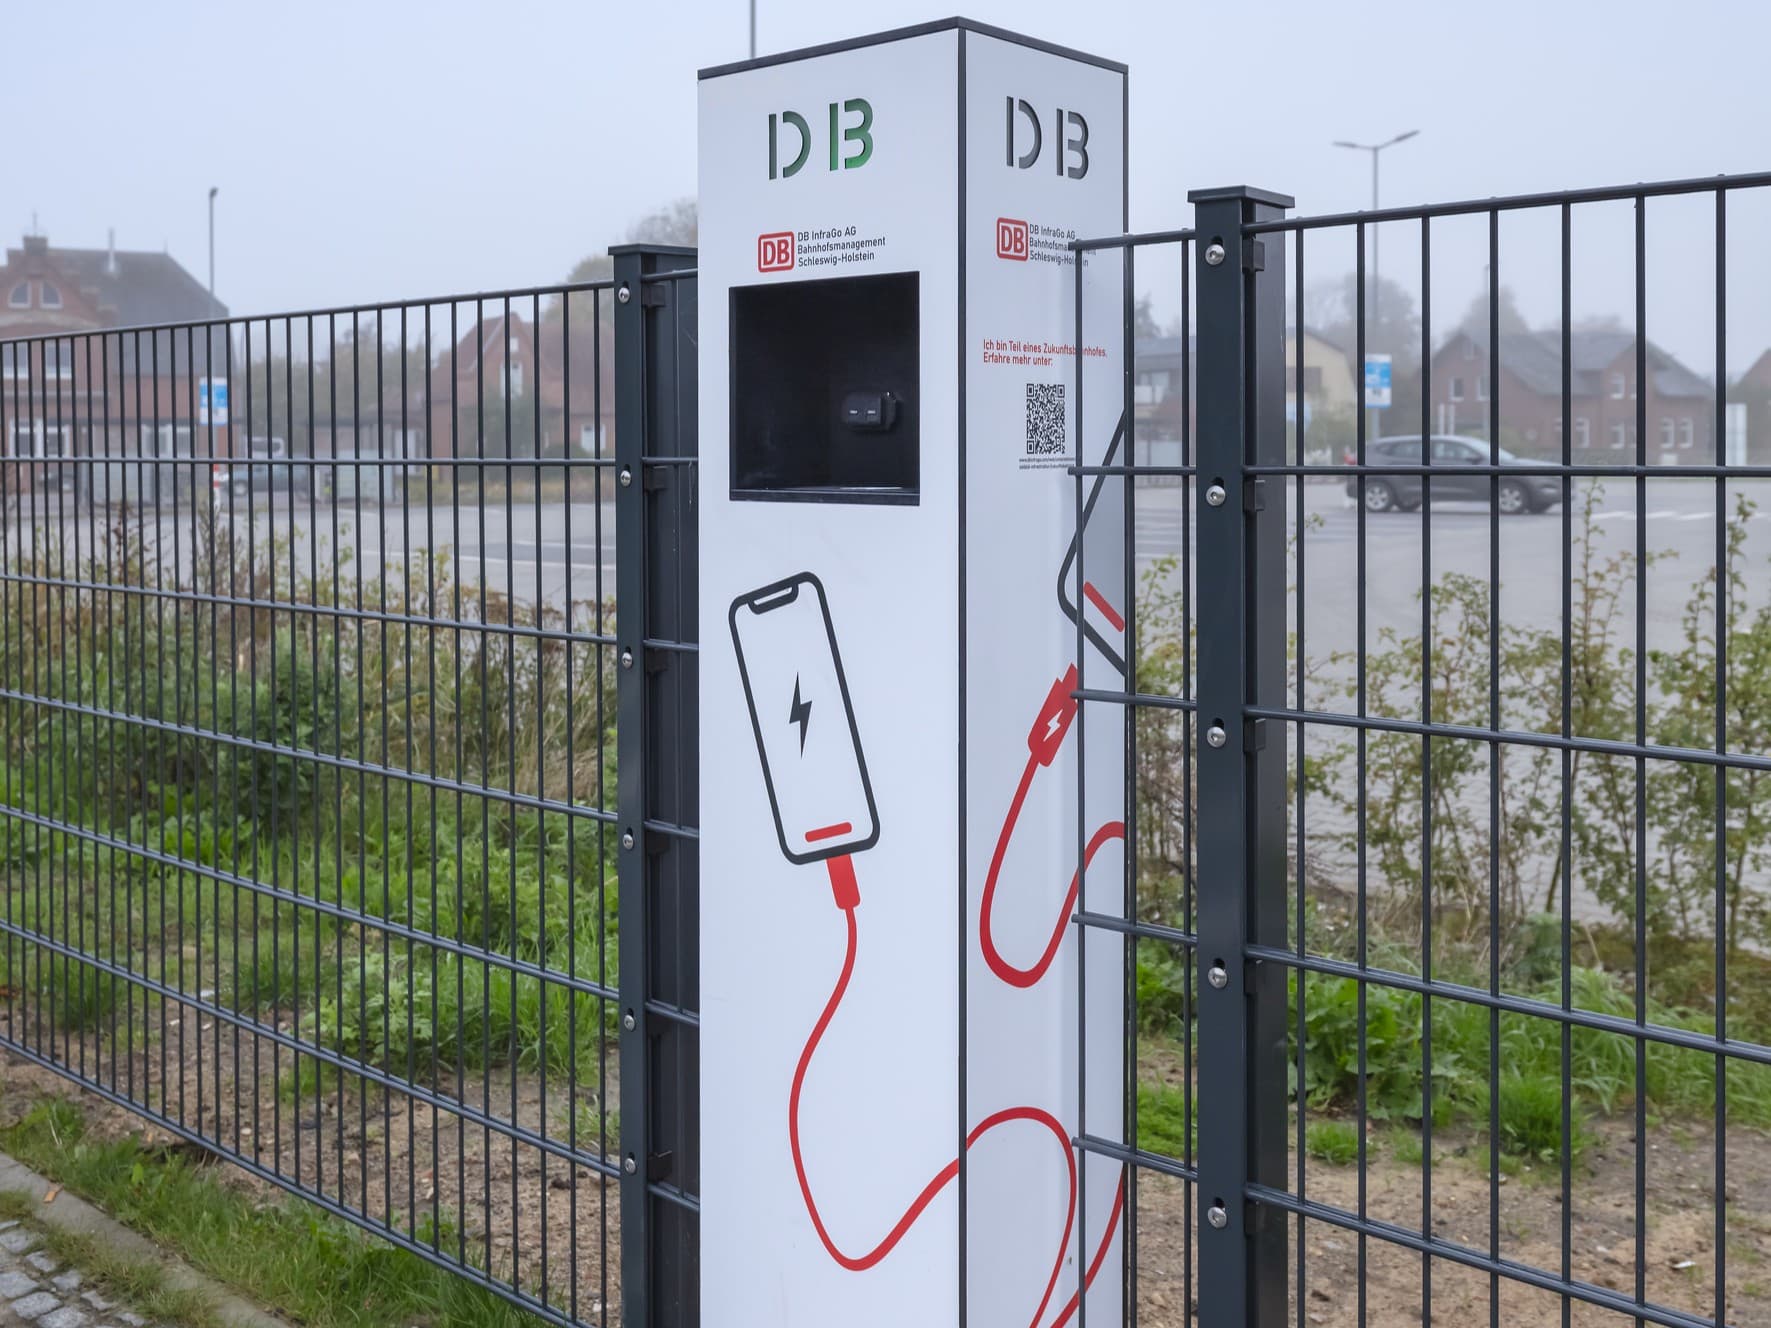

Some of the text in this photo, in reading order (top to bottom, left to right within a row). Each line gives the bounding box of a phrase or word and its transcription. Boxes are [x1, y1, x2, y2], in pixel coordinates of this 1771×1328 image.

[768, 97, 873, 180] DB
[1006, 96, 1089, 180] DB
[797, 226, 857, 241] DB InfraGo AG
[1001, 225, 1025, 254] DB
[1029, 224, 1039, 234] DB
[1066, 229, 1076, 240] AG
[763, 239, 790, 266] DB
[797, 237, 886, 255] Bahnhofsmanagement
[798, 250, 875, 267] Schleswig-Holstein
[983, 339, 994, 351] Ich
[996, 340, 1007, 351] bin
[1009, 340, 1021, 353] Teil
[1023, 342, 1042, 353] eines
[983, 351, 1053, 367] Erfahre mehr unter:
